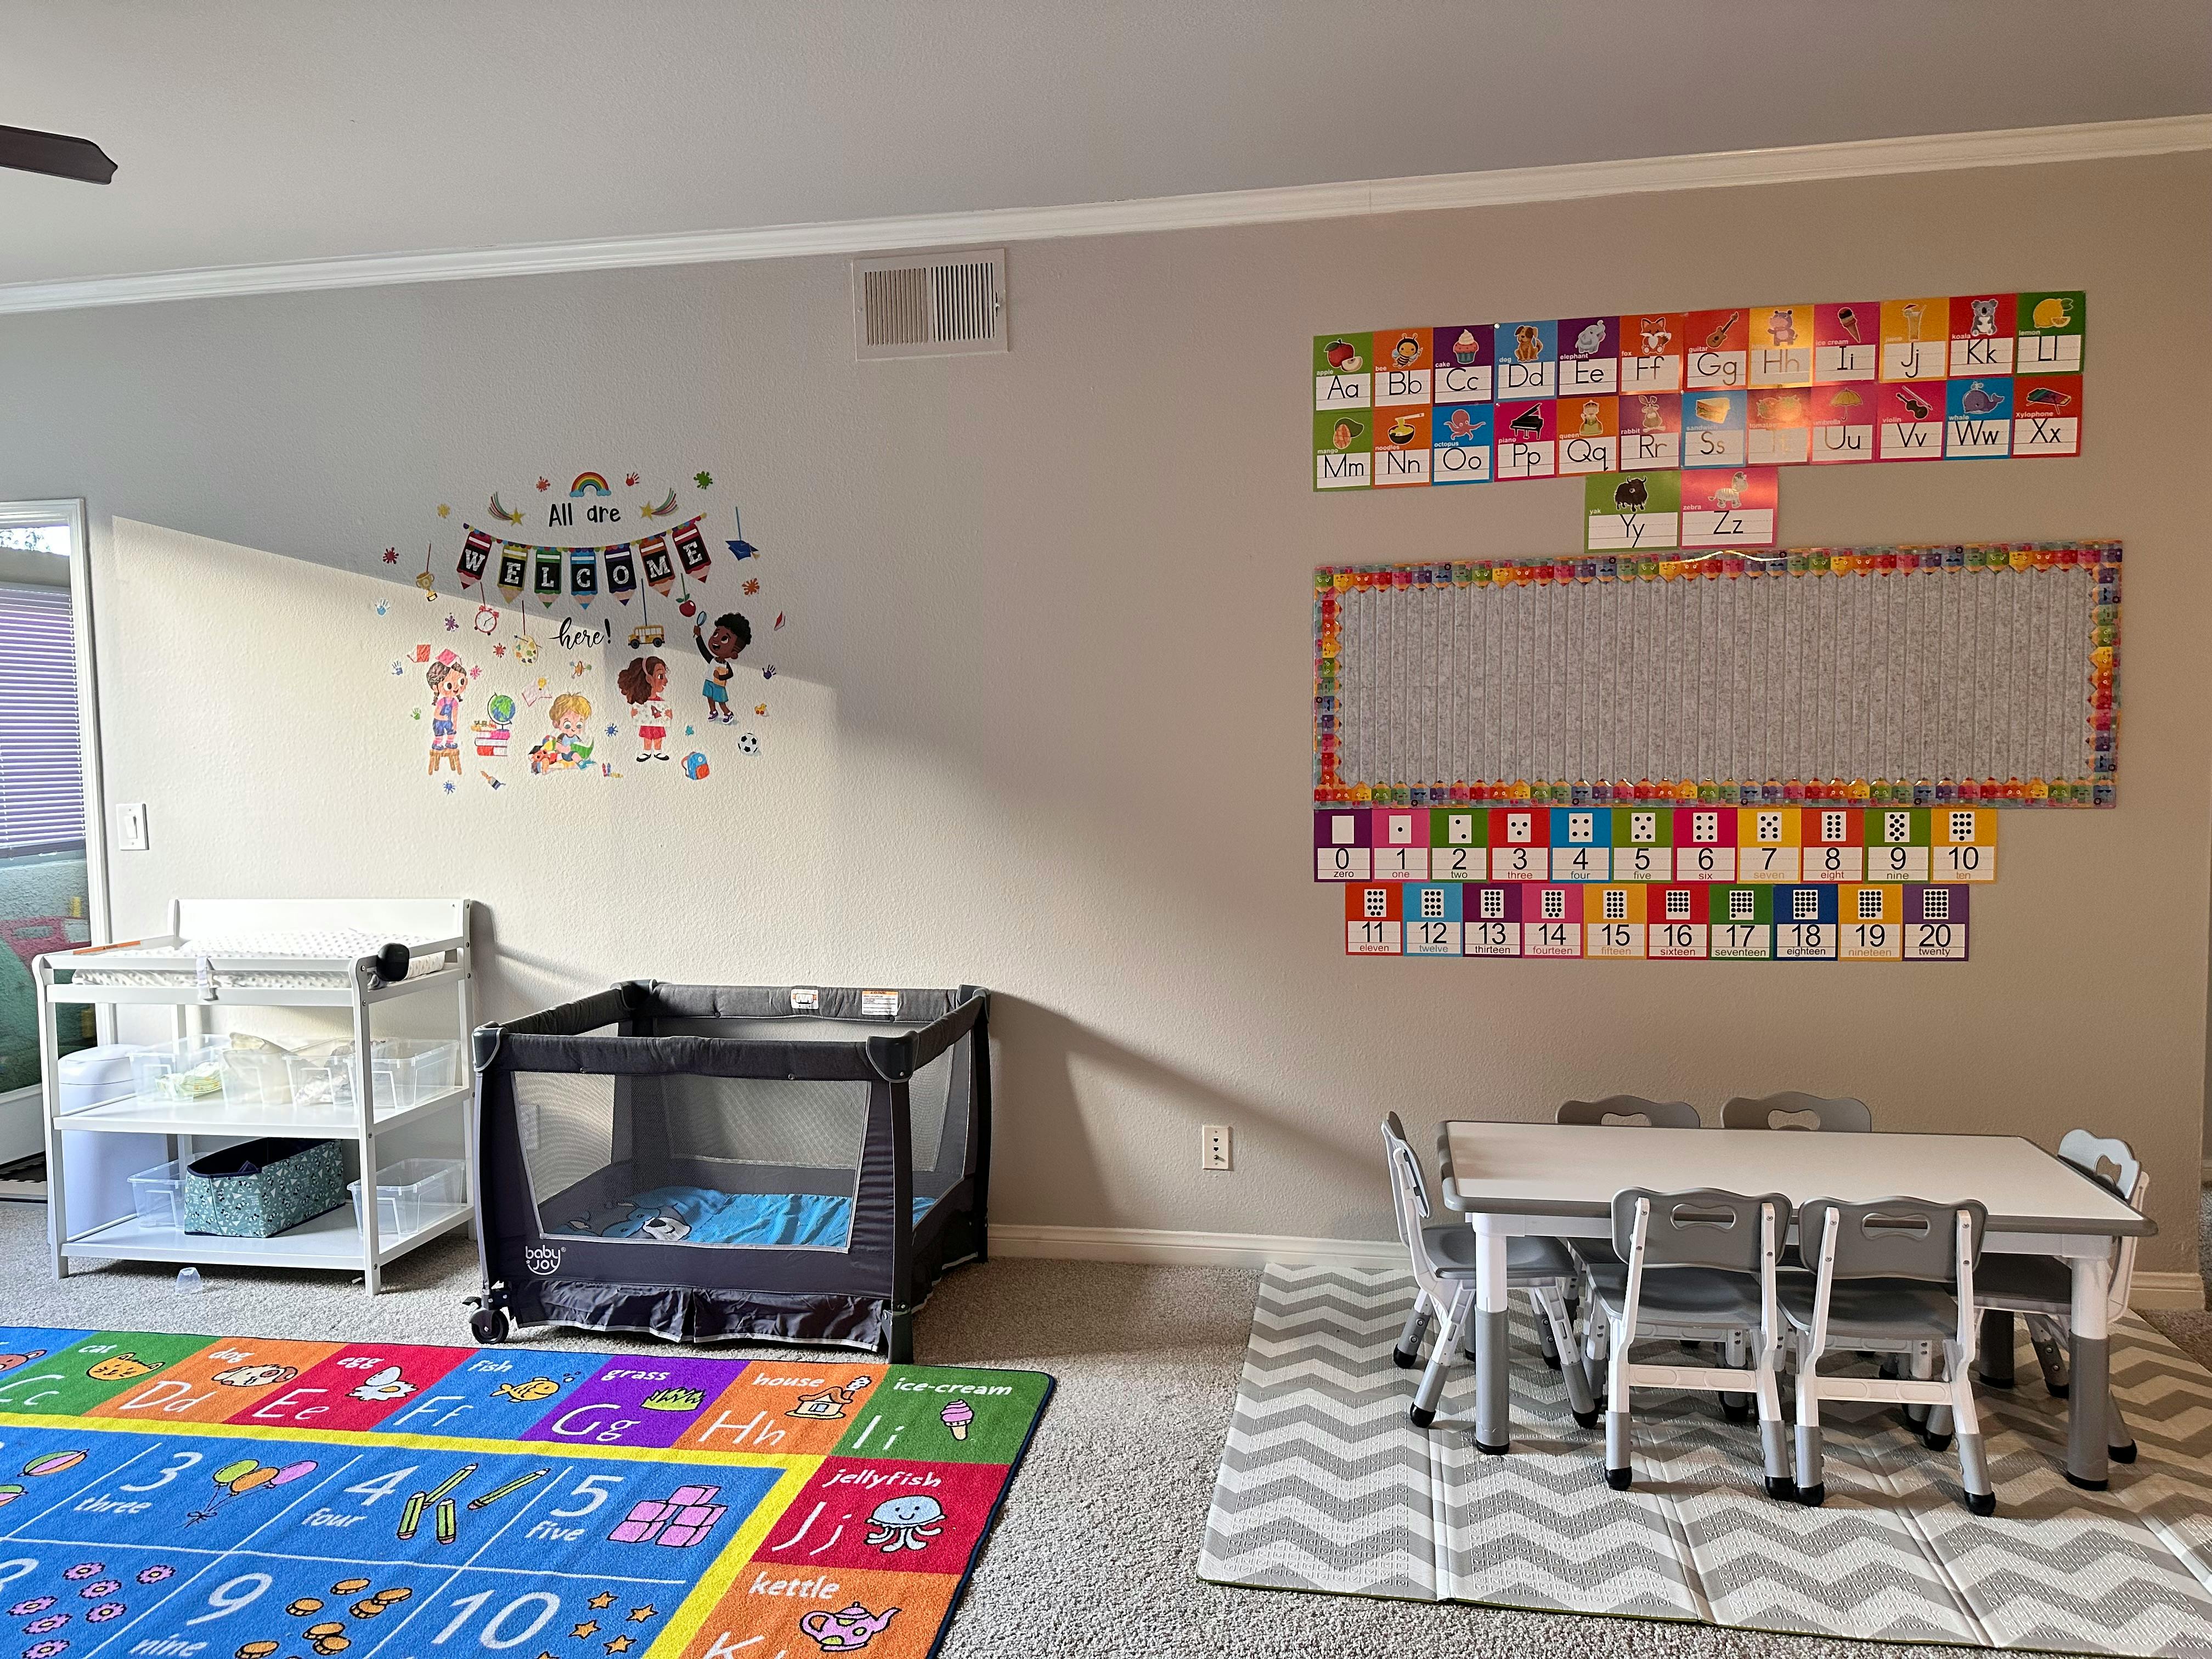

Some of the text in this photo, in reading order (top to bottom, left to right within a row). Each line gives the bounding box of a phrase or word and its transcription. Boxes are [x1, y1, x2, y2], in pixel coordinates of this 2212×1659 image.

[1837, 346, 1854, 370] Ii
[1901, 342, 1919, 377] Jj
[1967, 338, 1997, 364] Kk
[2038, 336, 2057, 362] Ll
[1576, 359, 1604, 383] Ee
[1637, 356, 1664, 380] Ff
[1697, 352, 1737, 386] Gg
[1764, 349, 1799, 374] Hh
[1389, 370, 1422, 395] Bb
[1446, 367, 1479, 391] Cc
[1509, 362, 1543, 388] Dd
[1327, 375, 1358, 399] Aa
[1825, 426, 1860, 450] Uu
[1897, 422, 1927, 447] Vv
[1955, 420, 1999, 445] Ww
[2029, 418, 2061, 443] Xx
[1640, 435, 1667, 459] Rr
[1701, 431, 1725, 454] Ss
[1324, 453, 1364, 478] Mm
[1387, 450, 1420, 474] Nn
[1443, 447, 1481, 471] Oo
[1513, 443, 1541, 477] Pp
[1567, 438, 1609, 472] Qq
[549, 503, 621, 527] All are
[1713, 510, 1743, 534] Zz
[1620, 514, 1645, 549] Yy
[464, 541, 703, 588] WELCOME
[548, 617, 611, 650] here!
[1335, 848, 1349, 870] 0
[1397, 849, 1405, 870] 1
[1452, 848, 1466, 870] 2
[1513, 848, 1527, 870] 3
[1572, 848, 1589, 870] 4
[1635, 848, 1650, 870] 5
[1698, 848, 1713, 870] 6
[1762, 848, 1777, 870] 7
[1825, 848, 1841, 870] 8
[1891, 847, 1906, 870] 9
[1948, 847, 1979, 870] 10
[1508, 871, 1533, 879] three
[1570, 871, 1590, 879] four
[1633, 871, 1651, 879] five
[1699, 872, 1713, 880] six
[1820, 871, 1844, 881] eight
[1887, 872, 1909, 880] nine
[1362, 921, 1383, 943] 11
[1420, 922, 1447, 944] 12
[1479, 923, 1506, 945] 13
[1538, 923, 1566, 946] 14
[1601, 924, 1630, 946] 15
[1663, 924, 1692, 946] 16
[1726, 925, 1755, 947] 17
[1791, 924, 1821, 947] 18
[1855, 924, 1885, 947] 19
[1918, 924, 1951, 947] 20
[1419, 944, 1448, 952] twelve
[1475, 945, 1510, 953] thirteen
[1533, 947, 1572, 955] fourteen
[1601, 947, 1631, 956] fifteen
[1660, 947, 1695, 956] sixteen
[1787, 947, 1826, 957] eighteen
[1848, 947, 1892, 956] nineteen
[1918, 947, 1950, 957] twenty
[78, 1344, 117, 1353] cat
[208, 1347, 254, 1364] dog
[337, 1356, 384, 1369] egg
[467, 1359, 514, 1373] fish
[601, 1369, 670, 1381] grass
[752, 1373, 825, 1387] house
[119, 1380, 218, 1413] Dd
[893, 1378, 1013, 1396] ice-cream
[252, 1389, 330, 1420] Ee
[393, 1396, 473, 1426] Ff
[551, 1403, 641, 1442] Gg
[698, 1410, 786, 1446] Hh
[119, 1452, 203, 1492] 3
[821, 1469, 942, 1489] jellyfish
[343, 1465, 420, 1506] 4
[550, 1475, 624, 1517] 5
[74, 1493, 152, 1514] three
[302, 1508, 368, 1527] four
[524, 1520, 585, 1541] five
[748, 1571, 839, 1600] kettle
[187, 1572, 272, 1626] 9
[431, 1589, 560, 1649] 10
[128, 1633, 208, 1656] nine
